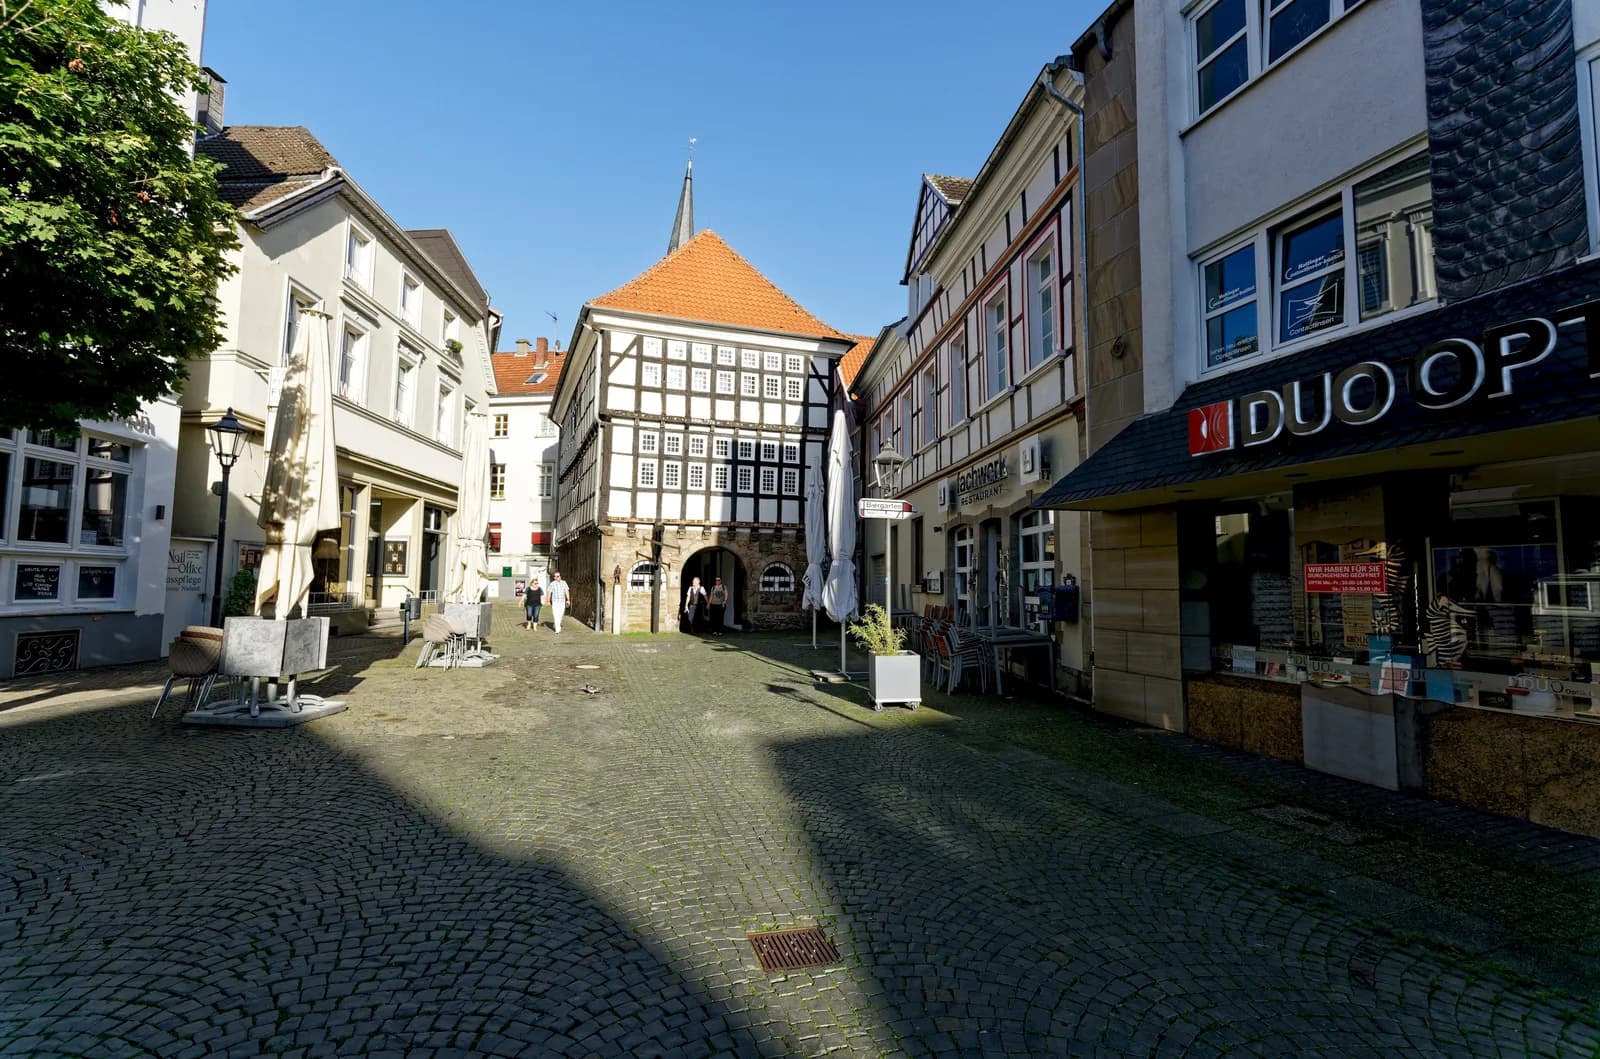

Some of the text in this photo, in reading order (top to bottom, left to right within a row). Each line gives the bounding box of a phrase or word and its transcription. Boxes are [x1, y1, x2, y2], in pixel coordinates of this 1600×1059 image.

[1239, 360, 1396, 448] DUO
[961, 486, 1003, 506] RESTAURANT
[866, 501, 902, 510] Biergarten
[178, 561, 203, 575] Office
[1324, 565, 1350, 573] HABEN
[1352, 564, 1367, 572] FÜR
